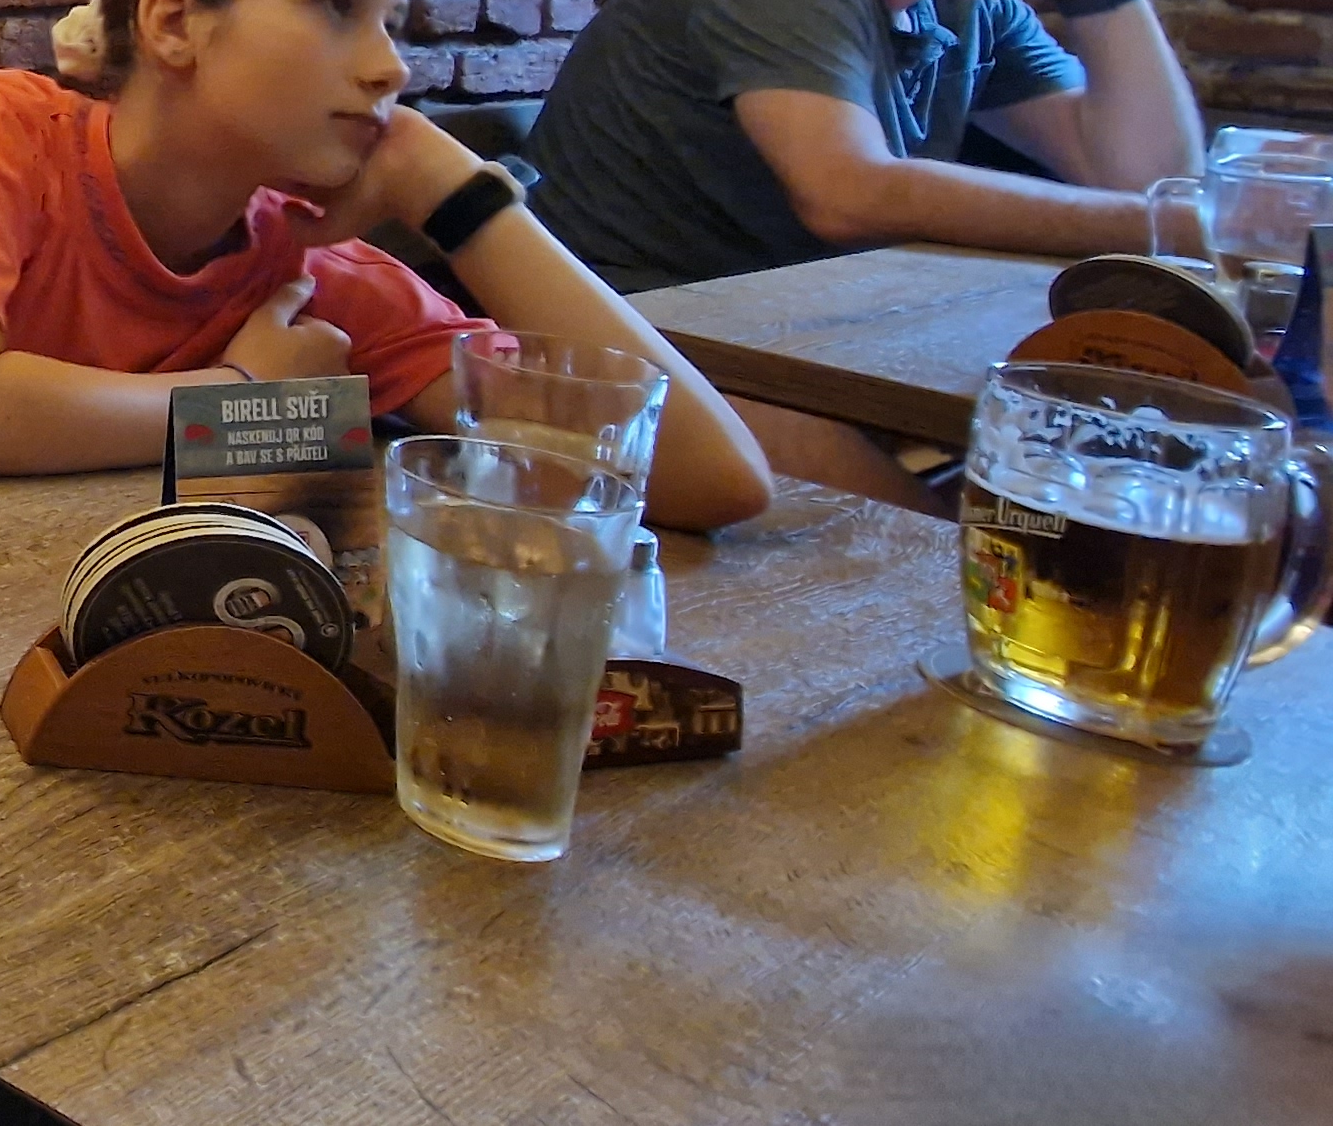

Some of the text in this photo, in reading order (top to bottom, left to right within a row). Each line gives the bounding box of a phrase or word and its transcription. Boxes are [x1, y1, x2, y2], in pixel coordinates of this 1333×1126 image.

[221, 389, 330, 423] BIRELL SVĚT
[227, 428, 283, 446] NASKENUJ
[285, 426, 300, 442] QR
[226, 450, 234, 466] A
[236, 448, 258, 465] BAV
[260, 448, 274, 464] SE
[276, 447, 285, 463] S
[123, 691, 313, 749] Kozel
